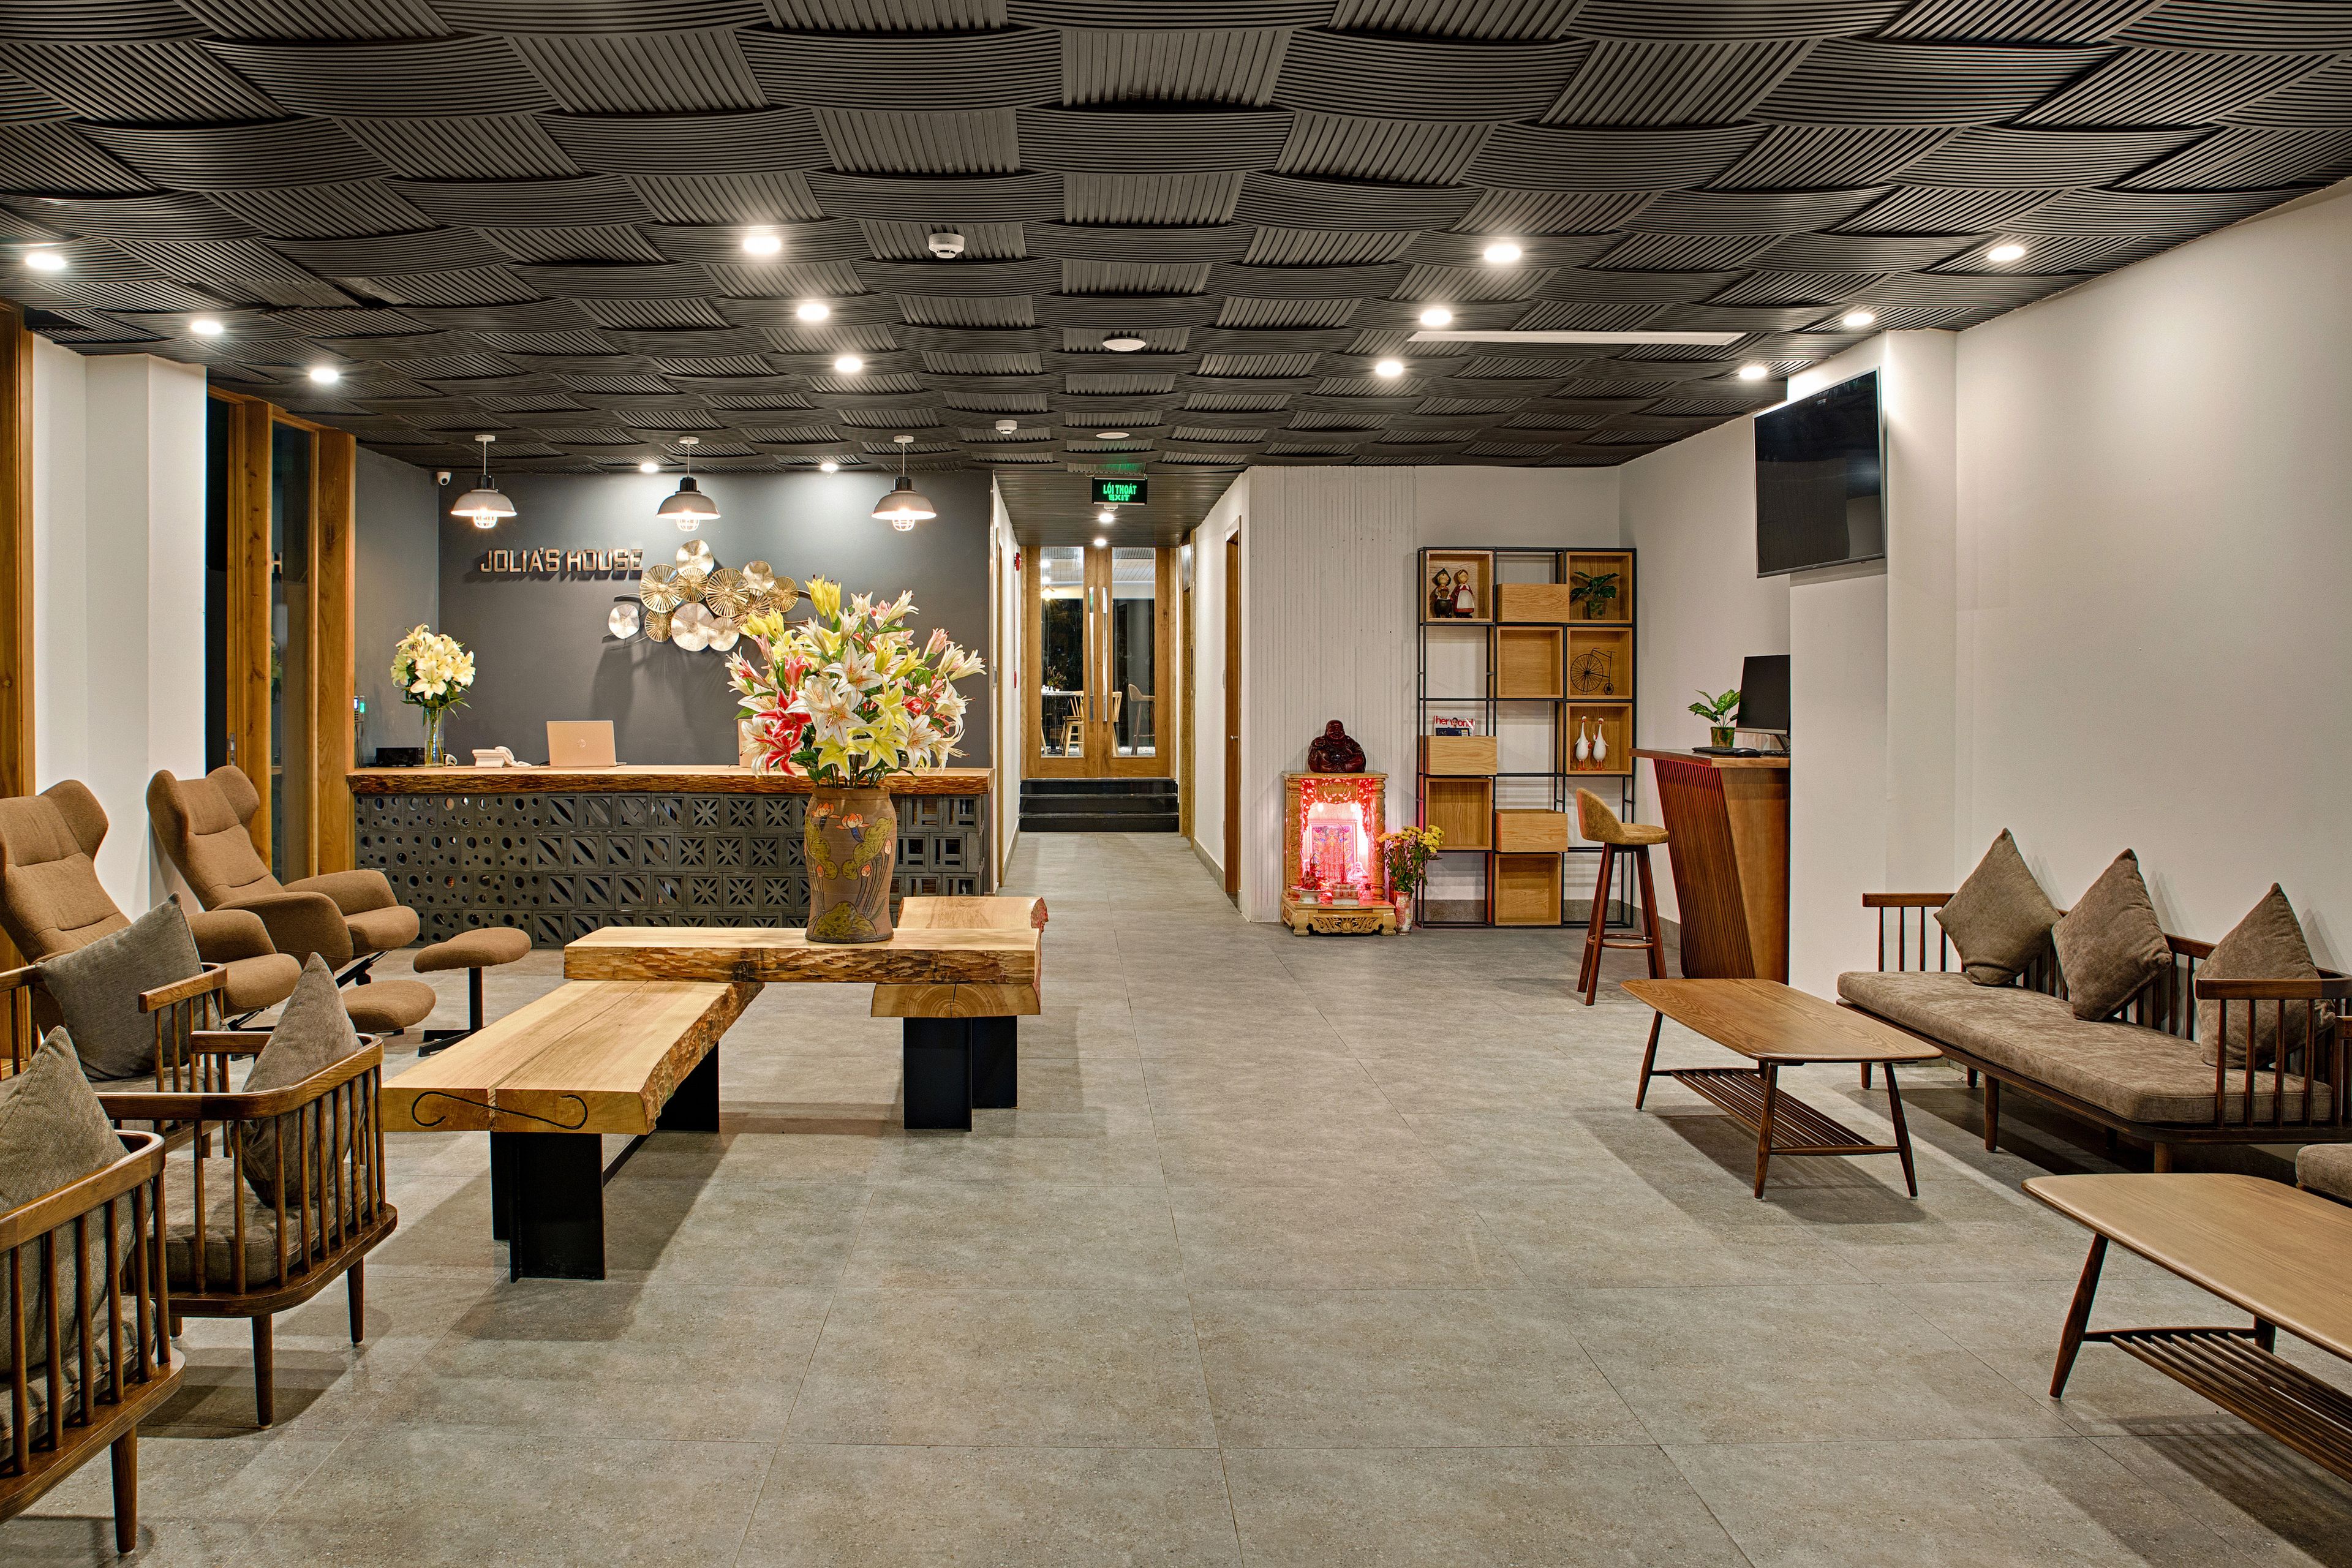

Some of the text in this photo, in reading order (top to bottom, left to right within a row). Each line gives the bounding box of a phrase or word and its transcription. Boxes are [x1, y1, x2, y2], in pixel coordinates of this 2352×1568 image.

[1102, 482, 1137, 495] LỐI THOÁT
[480, 548, 643, 573] JOLIA'S HOUSE
[1435, 715, 1450, 725] her
